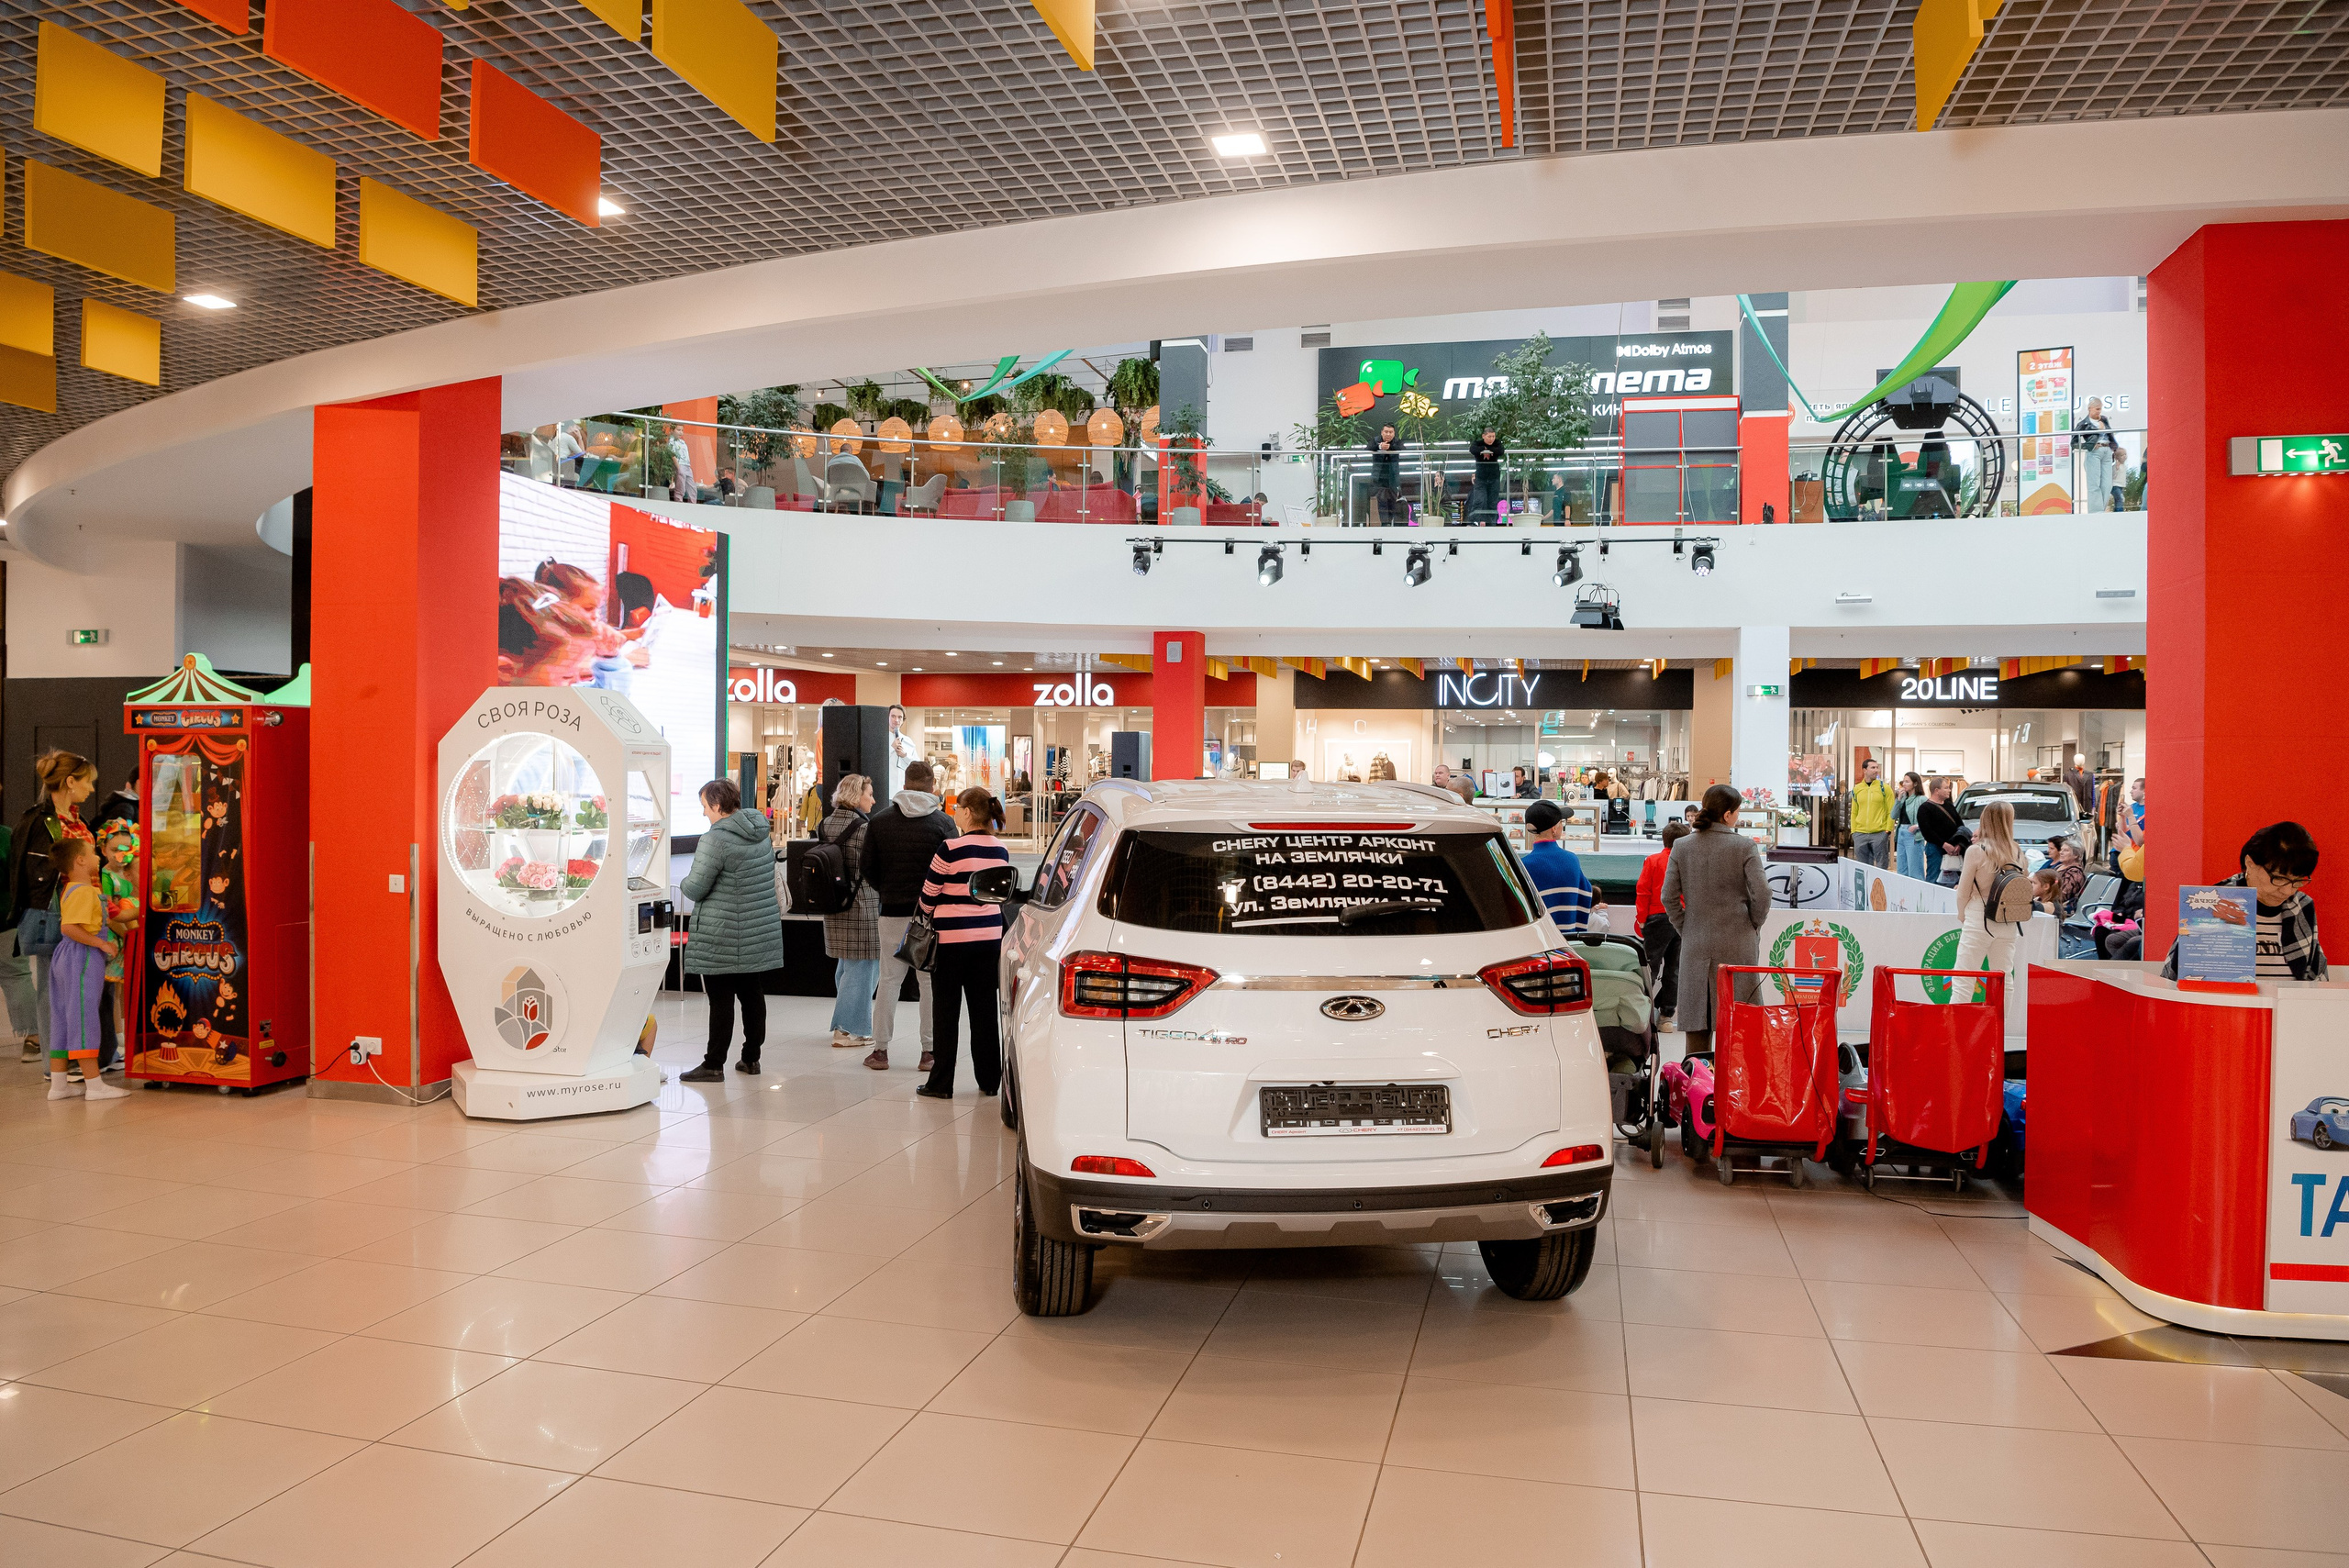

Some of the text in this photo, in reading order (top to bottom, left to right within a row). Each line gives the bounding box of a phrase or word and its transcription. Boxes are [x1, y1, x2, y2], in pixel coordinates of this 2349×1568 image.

[1631, 343, 1712, 358] Dolby Atmos
[1987, 398, 2011, 412] LE
[1033, 673, 1115, 706] zolla
[1439, 673, 1541, 706] INCITY
[1900, 676, 1998, 700] 20LINE
[181, 710, 222, 727] CIRCUS
[477, 701, 582, 731] СВОЯ РОЗА
[1212, 836, 1436, 852] CHERY ЦЕНТР АРКОНТ
[1255, 851, 1404, 865] НА ЗЕМЛЯЧКИ
[1217, 873, 1449, 894] +7 (8442) 20-20-71
[1230, 900, 1264, 917] ул.
[465, 907, 592, 941] ВЫРАЩЕНО С ЛЮБОВЬЮ
[153, 929, 237, 974] MONKEY CIRCUS
[1139, 1029, 1197, 1040] TIGGO
[1486, 1024, 1541, 1039] CHERY
[527, 1082, 622, 1098] www.myrose.ru
